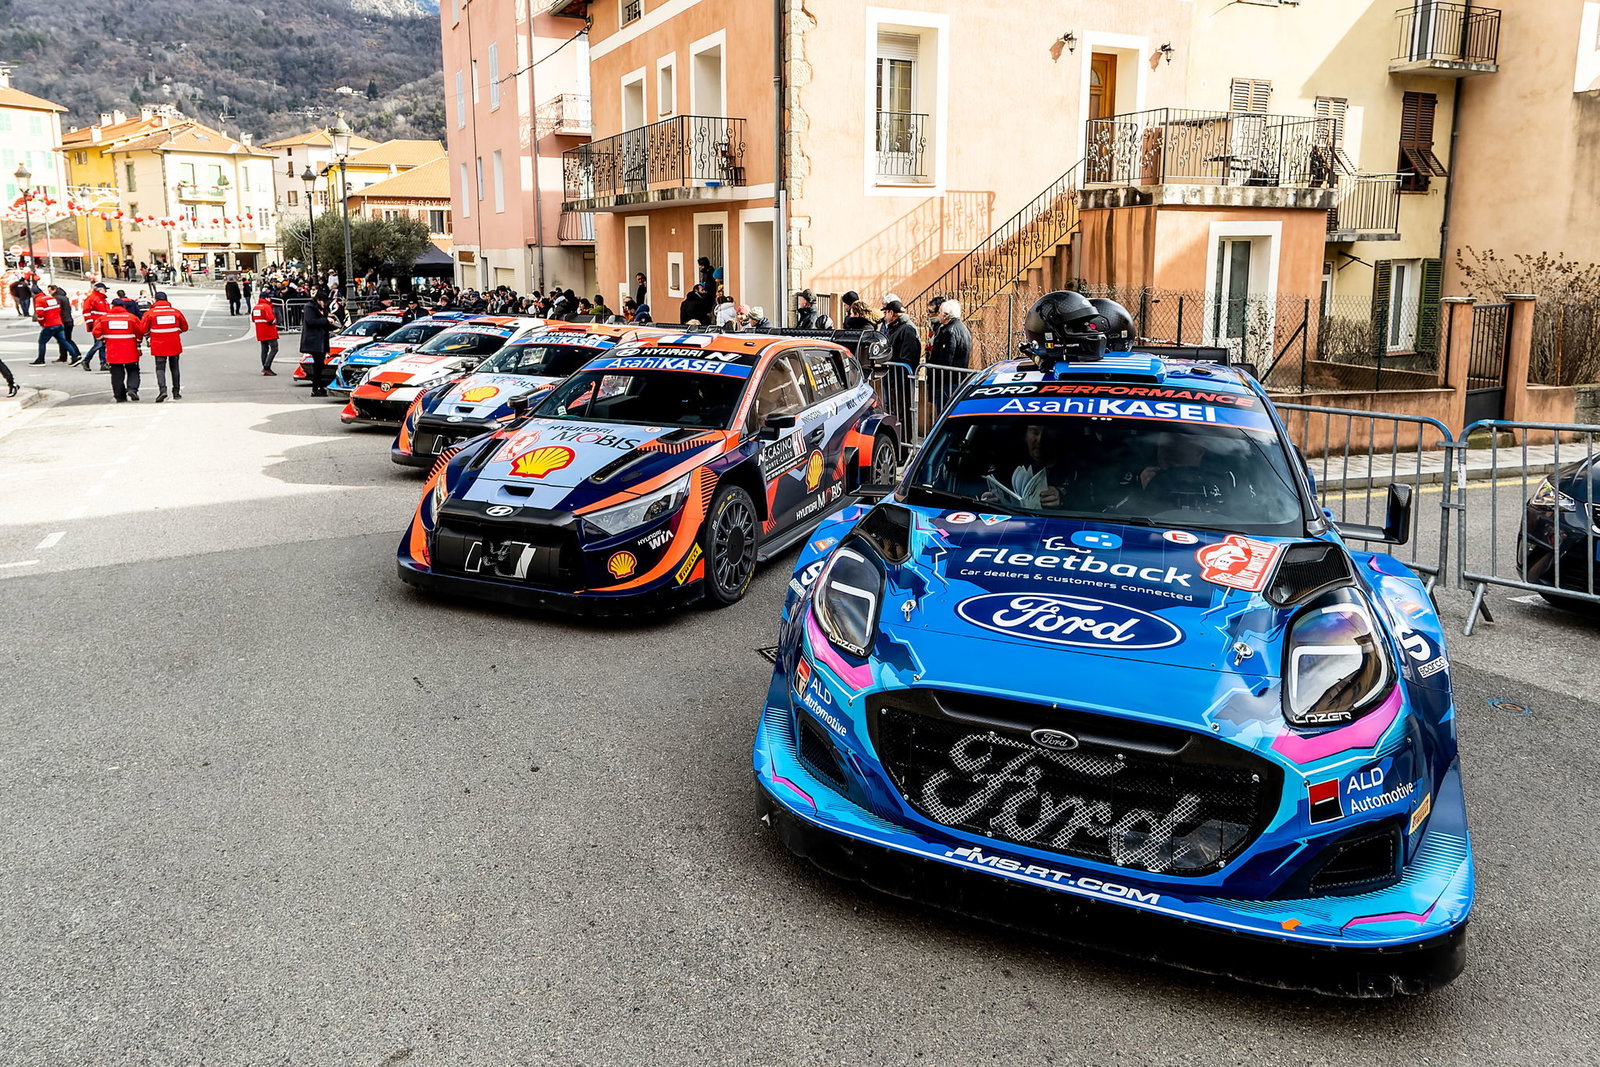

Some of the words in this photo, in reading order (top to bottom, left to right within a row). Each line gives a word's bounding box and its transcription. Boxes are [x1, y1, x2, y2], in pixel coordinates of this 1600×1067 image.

[527, 336, 601, 350] AsahiKASEI
[641, 348, 705, 357] HYUNDAI
[605, 357, 726, 374] AsahiKASEI
[1011, 372, 1027, 382] 9
[969, 385, 1038, 398] FORD
[1038, 385, 1255, 408] PERFORMANCE
[998, 397, 1217, 422] AsahiKASEI
[547, 425, 615, 435] HYUNDAI
[551, 431, 641, 451] MOBIS
[768, 437, 792, 459] CASINO
[637, 529, 662, 546] HYUNDAI
[965, 547, 1193, 588] Fleetback
[960, 568, 978, 577] Car
[980, 570, 1031, 581] dealers
[1046, 575, 1117, 590] customers
[1120, 583, 1193, 602] connected
[992, 596, 1142, 643] Ford
[1420, 657, 1446, 676] sparco
[810, 676, 833, 705] ALD
[803, 692, 847, 737] Automotive
[1040, 731, 1069, 748] Ford
[1346, 766, 1385, 795] ALD
[922, 733, 1201, 872] Ford
[1350, 781, 1414, 814] Automotive
[966, 847, 1161, 905] MS-RT.COM
